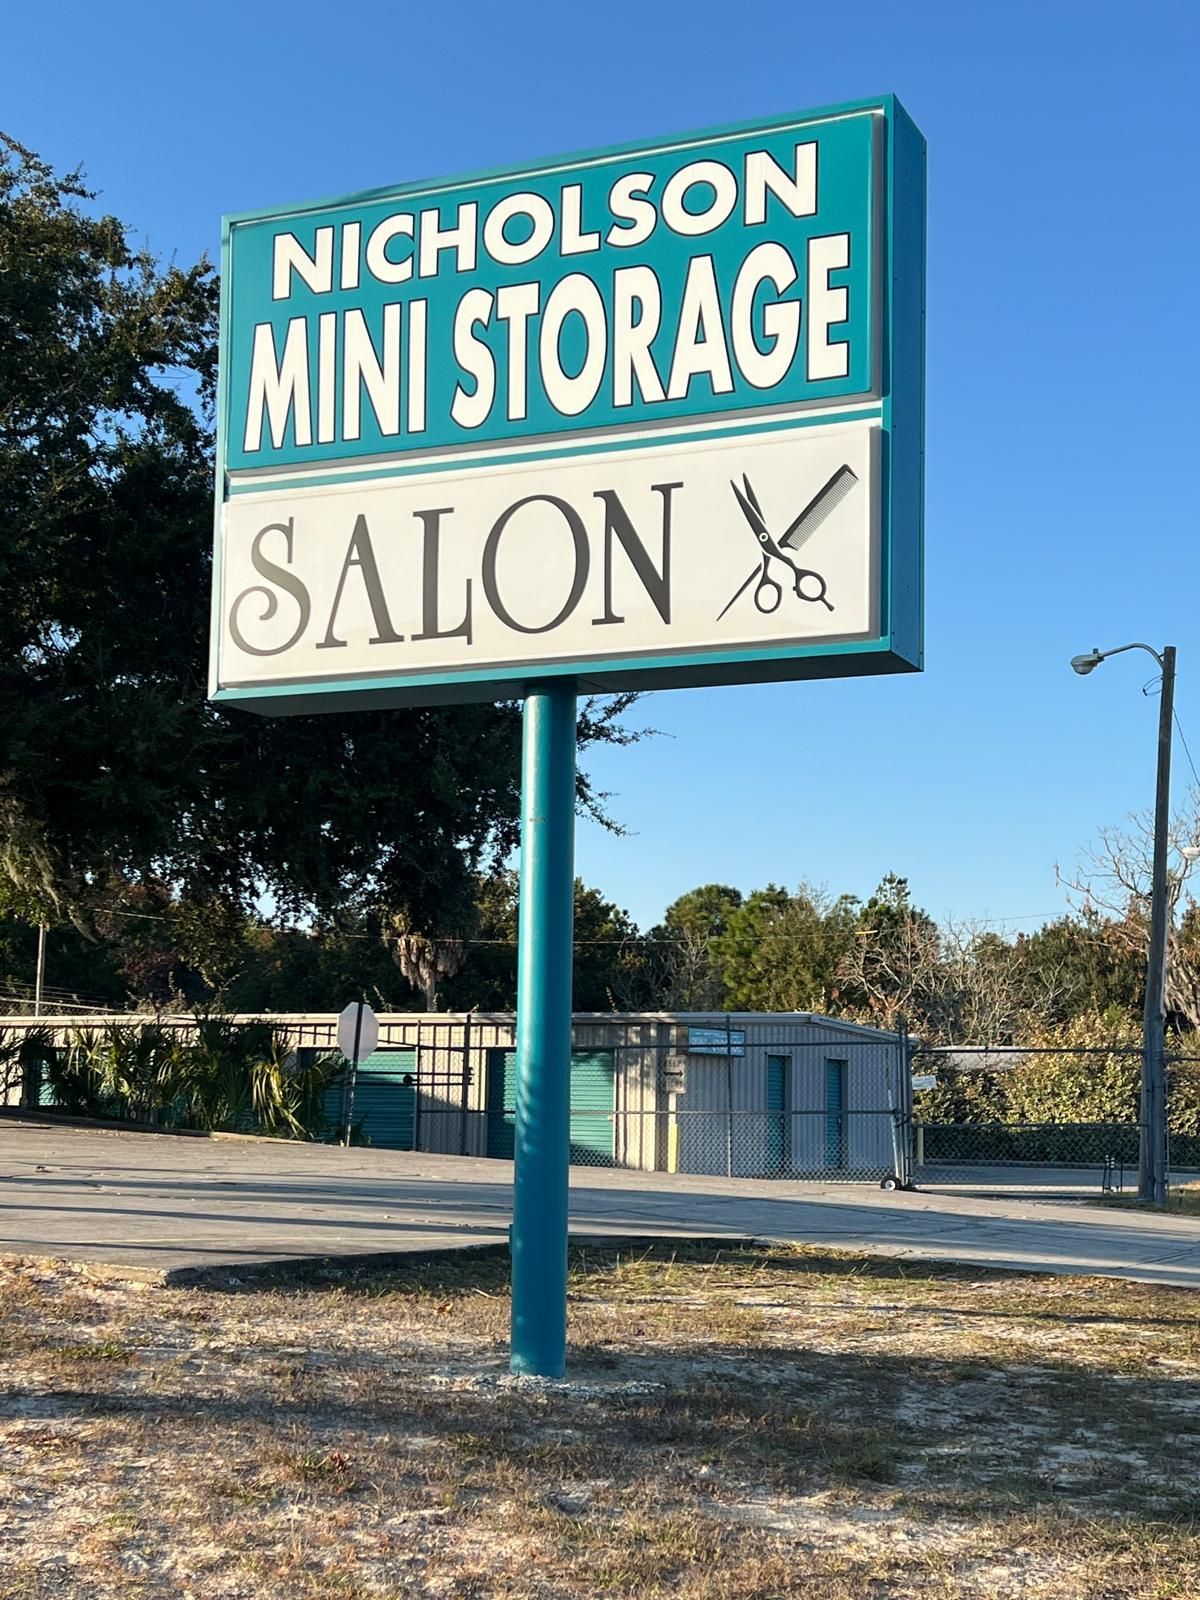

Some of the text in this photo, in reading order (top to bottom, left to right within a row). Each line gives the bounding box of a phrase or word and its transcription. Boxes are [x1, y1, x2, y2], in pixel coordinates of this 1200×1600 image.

[272, 141, 819, 300] NICHOLSON
[242, 232, 851, 453] MINI STORAGE
[229, 482, 684, 656] SALON
